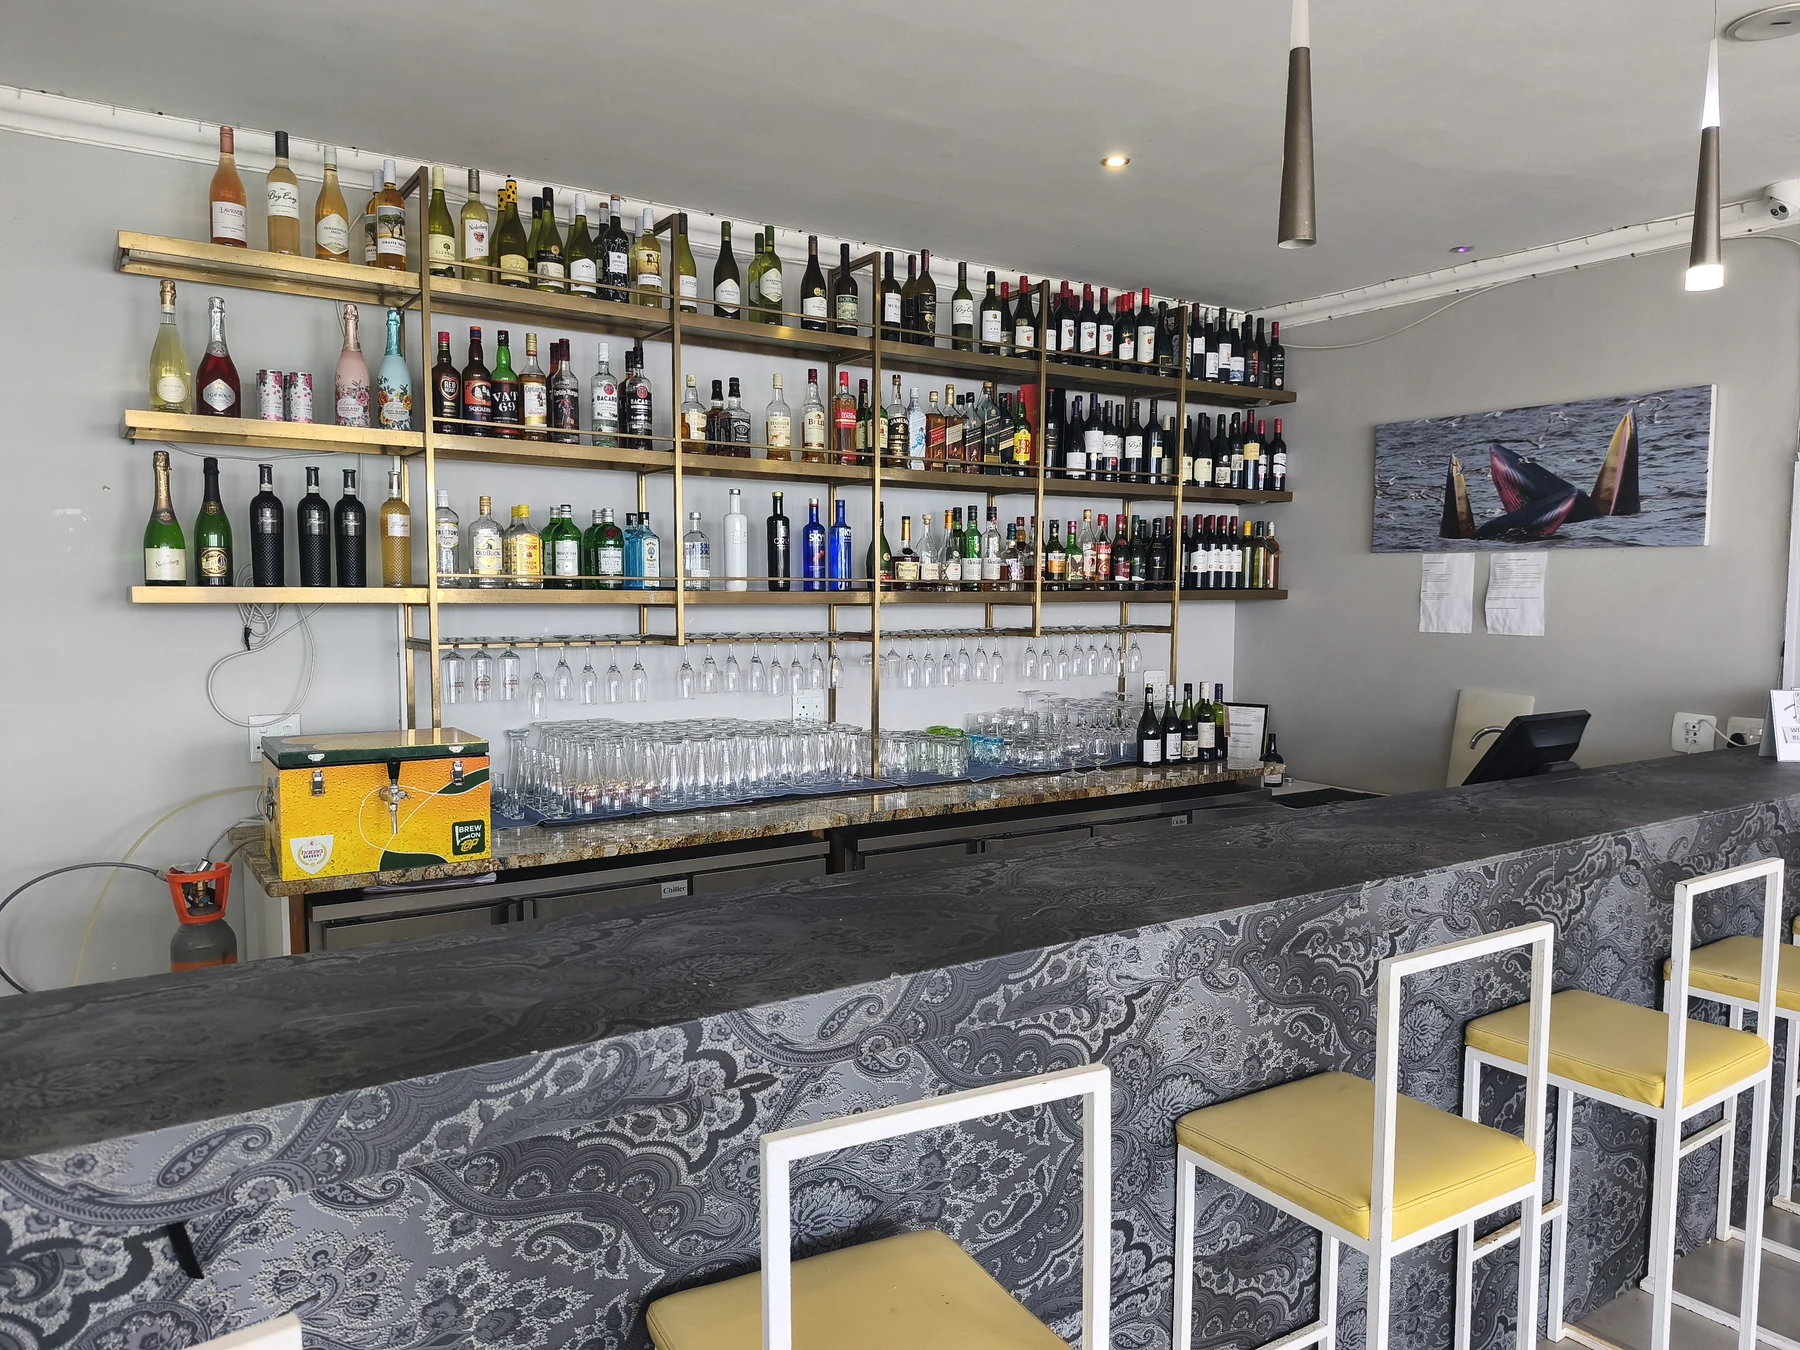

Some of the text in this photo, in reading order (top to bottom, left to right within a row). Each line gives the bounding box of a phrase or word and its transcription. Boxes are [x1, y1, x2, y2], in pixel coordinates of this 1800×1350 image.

[267, 189, 282, 202] Big
[444, 380, 456, 388] RED
[492, 391, 518, 403] VAT
[498, 402, 516, 412] 69
[458, 824, 482, 833] BREW
